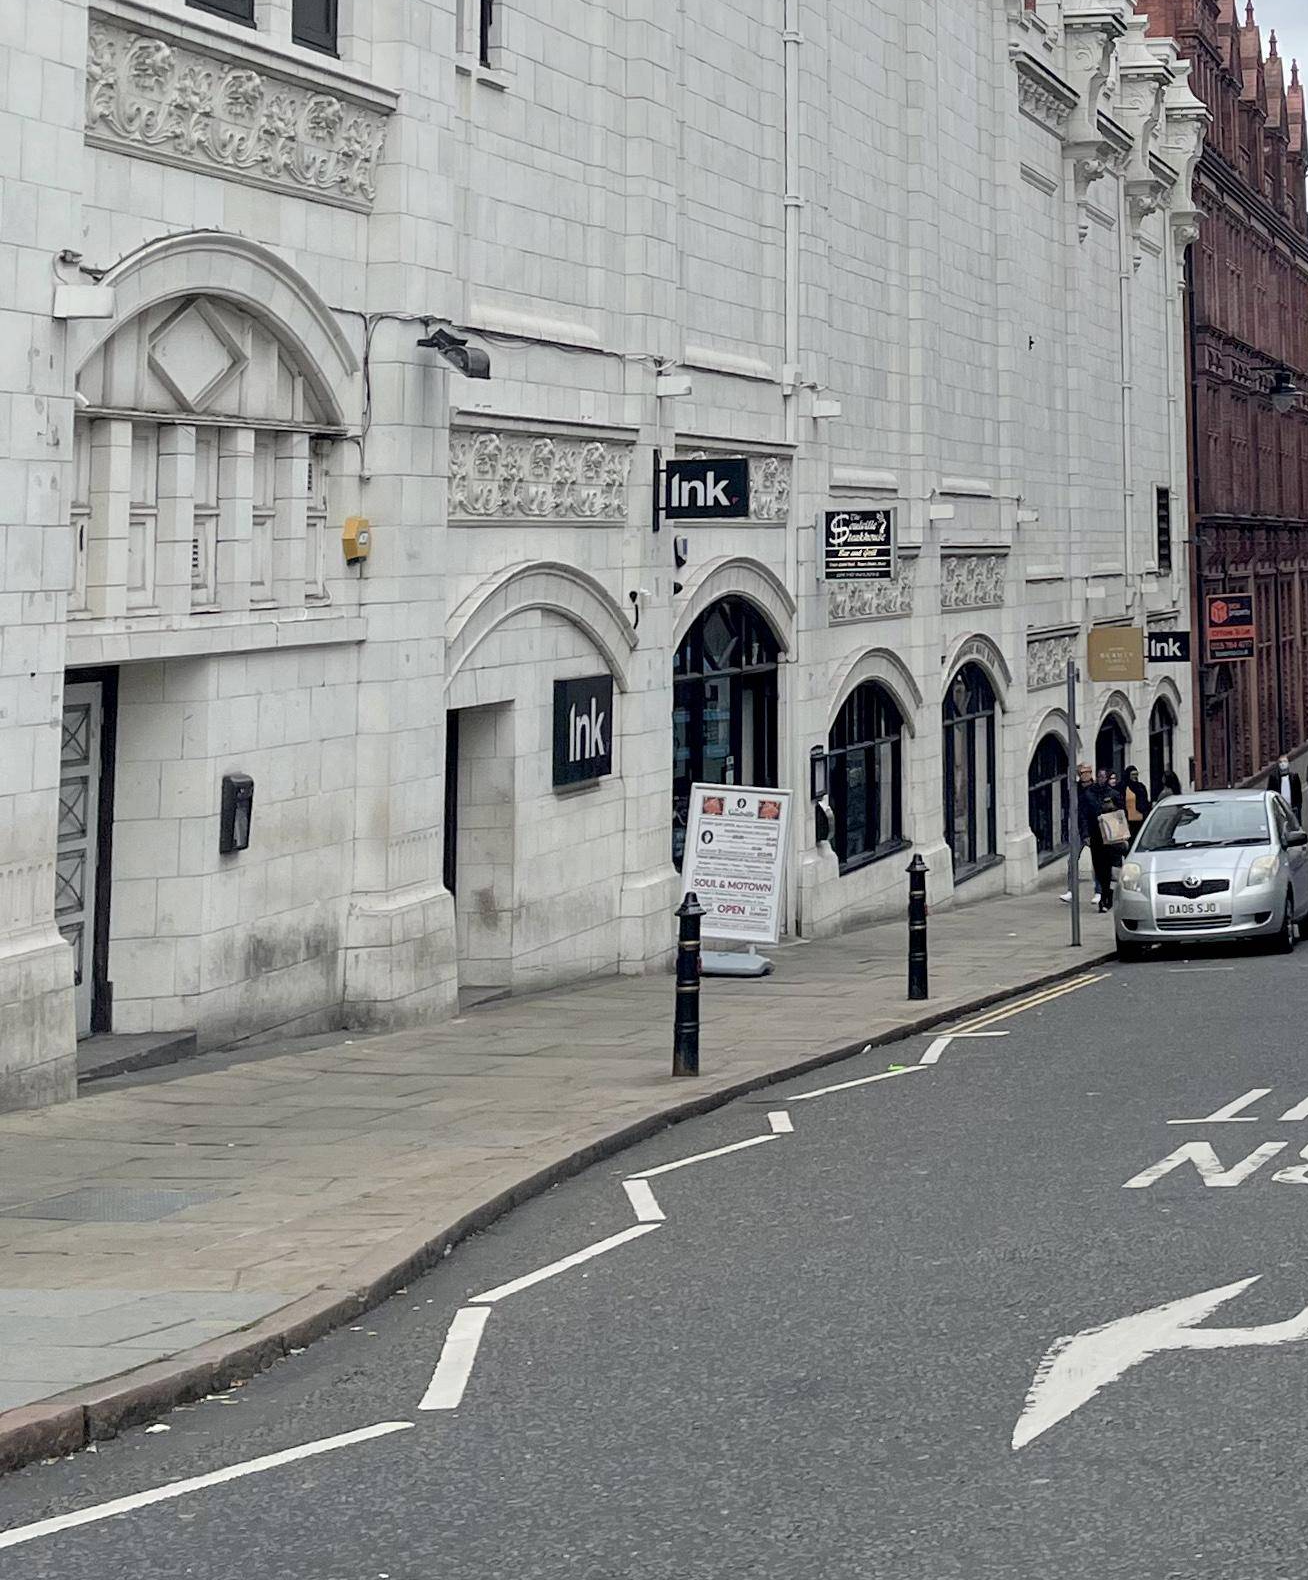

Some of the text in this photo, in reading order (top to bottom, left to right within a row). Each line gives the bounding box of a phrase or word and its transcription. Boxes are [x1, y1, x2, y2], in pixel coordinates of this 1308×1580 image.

[671, 470, 731, 508] Ink
[1150, 637, 1182, 657] Ink
[568, 696, 605, 762] Ink
[694, 879, 772, 892] SOUL & MOTOWN
[717, 905, 745, 915] OPEN
